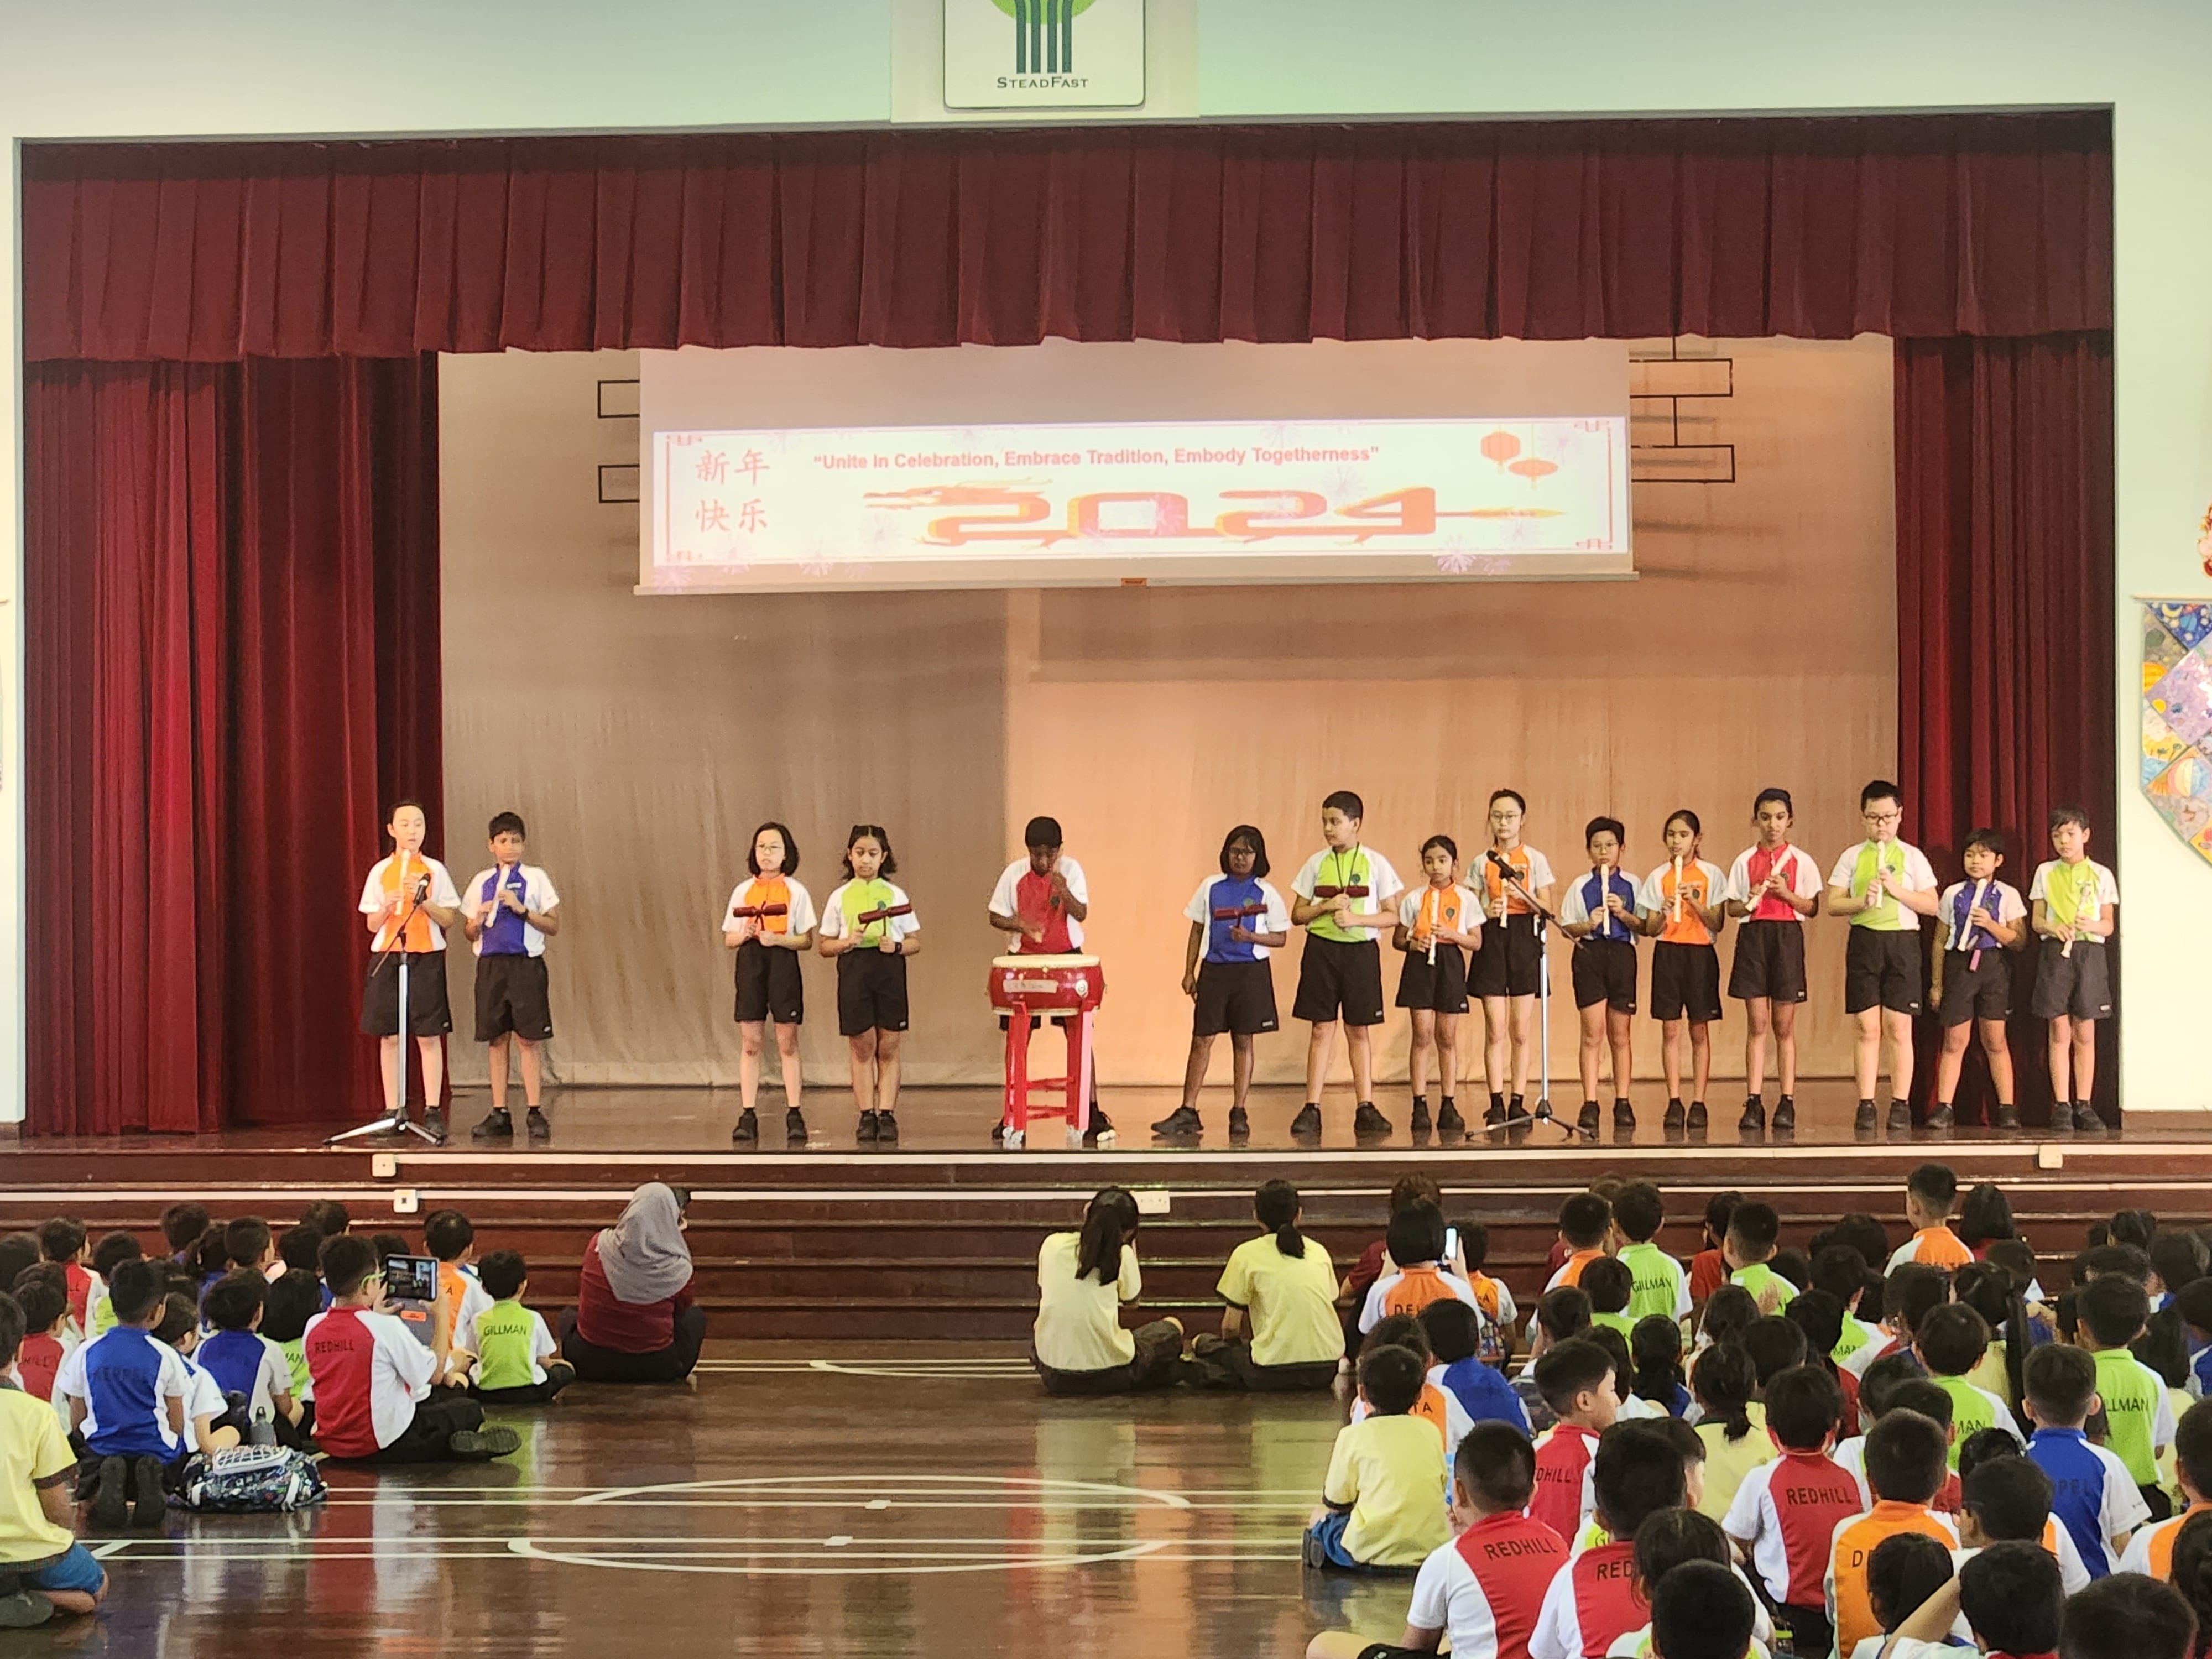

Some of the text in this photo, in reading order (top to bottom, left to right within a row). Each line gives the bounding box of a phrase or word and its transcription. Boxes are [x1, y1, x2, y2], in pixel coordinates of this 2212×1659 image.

[695, 448, 770, 485] 新年
[894, 451, 999, 469] Celebration,
[1004, 451, 1081, 466] Embrace
[1086, 448, 1168, 466] Tradition,
[1174, 448, 1246, 466] Embody
[695, 498, 768, 533] 快乐
[483, 1324, 528, 1337] GILLMAN
[315, 1339, 354, 1354] REDHILL
[1536, 1467, 1571, 1483] DHILL
[1786, 1487, 1853, 1505] REDHILL
[1483, 1537, 1558, 1560] REDHILL
